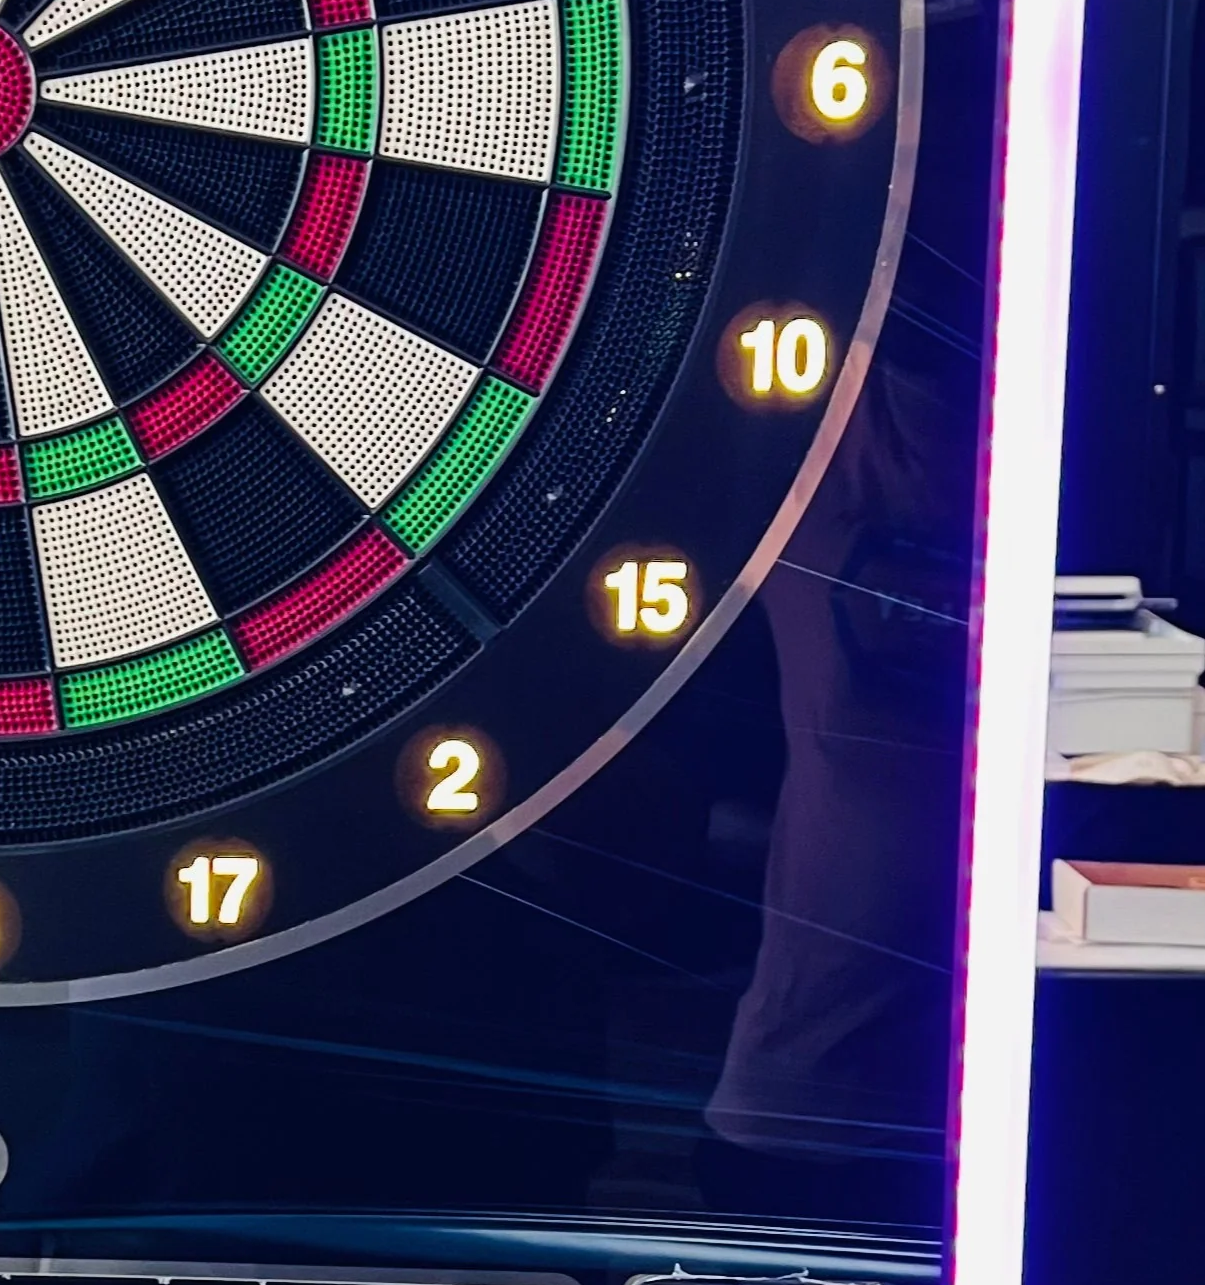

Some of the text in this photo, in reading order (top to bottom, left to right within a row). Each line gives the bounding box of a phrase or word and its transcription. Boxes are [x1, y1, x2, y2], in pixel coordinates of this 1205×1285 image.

[810, 39, 868, 121] 6
[740, 317, 827, 395] 10
[604, 560, 689, 634] 15
[426, 739, 481, 811] 2
[177, 855, 259, 925] 17
